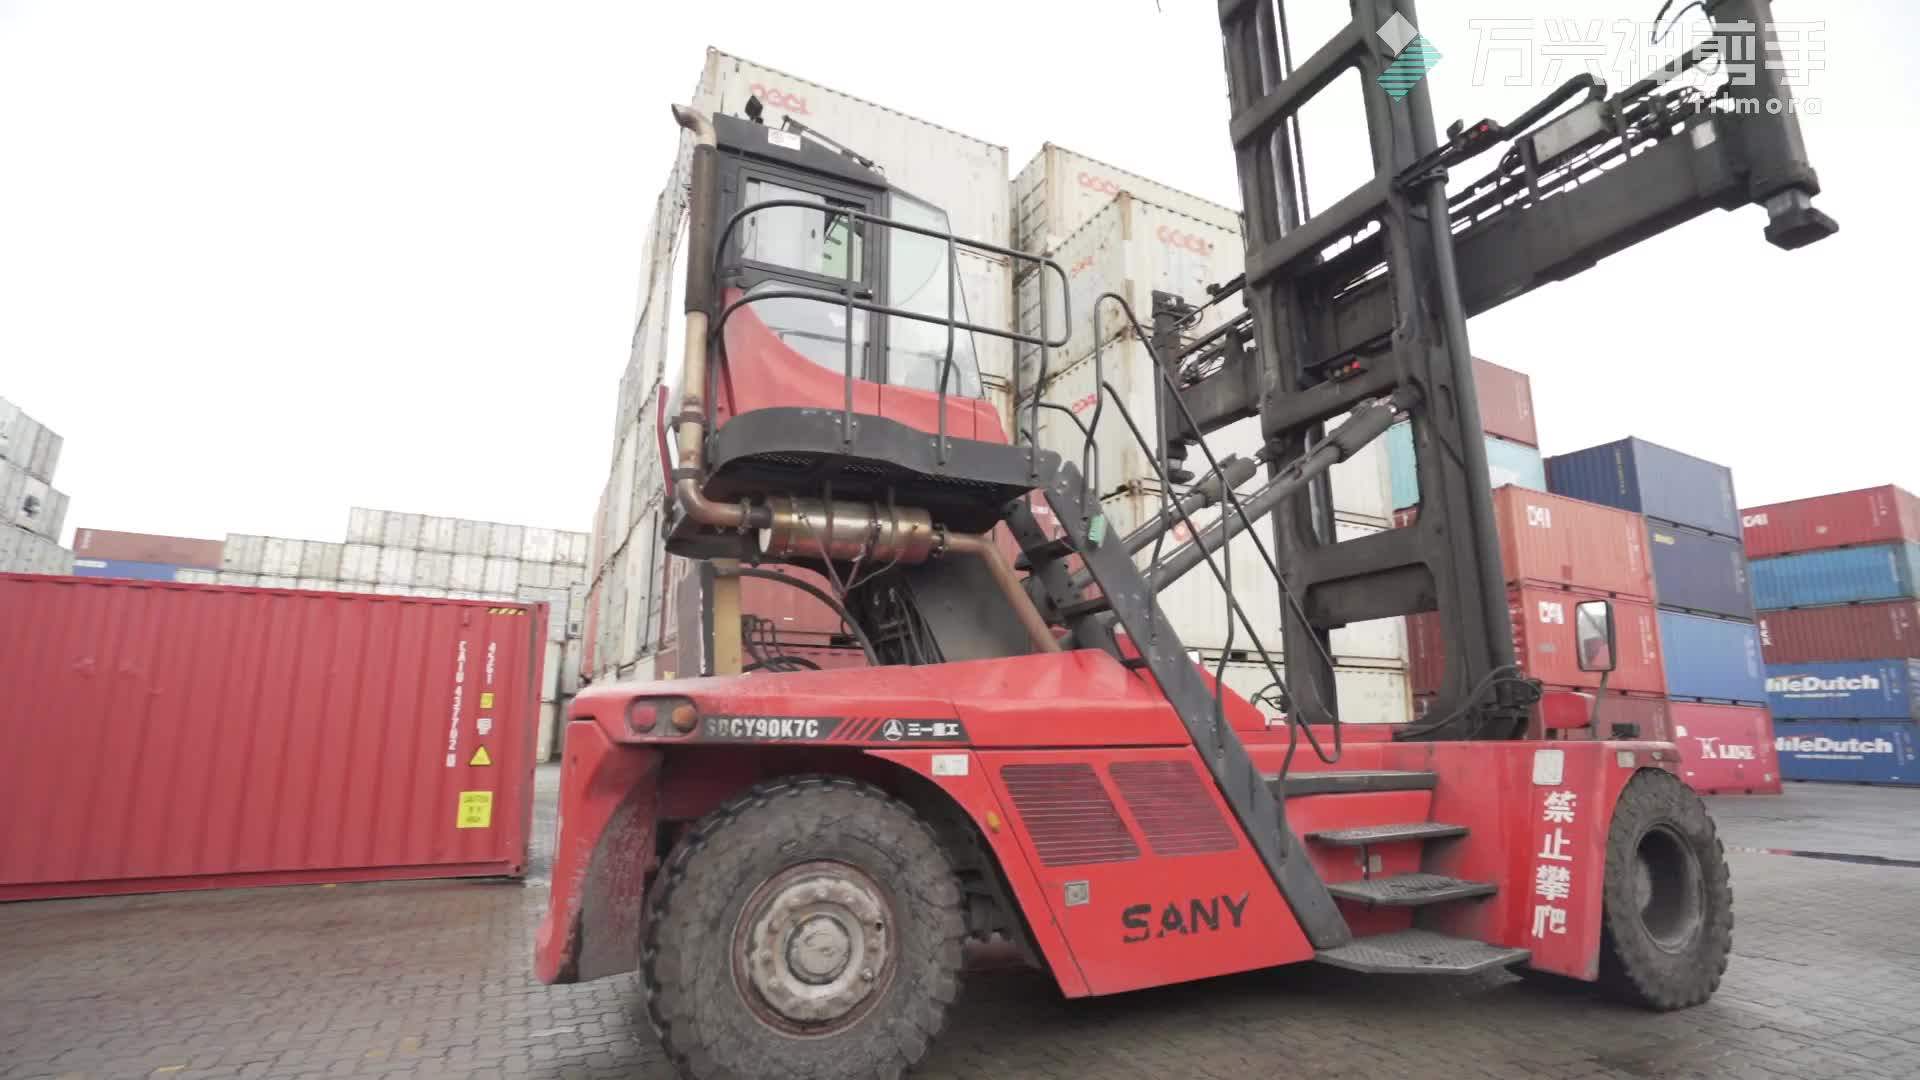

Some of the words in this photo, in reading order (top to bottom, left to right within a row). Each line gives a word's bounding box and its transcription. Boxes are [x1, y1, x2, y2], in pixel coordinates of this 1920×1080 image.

[1531, 790, 1577, 940] 禁止攀爬
[1121, 892, 1249, 943] SANY
